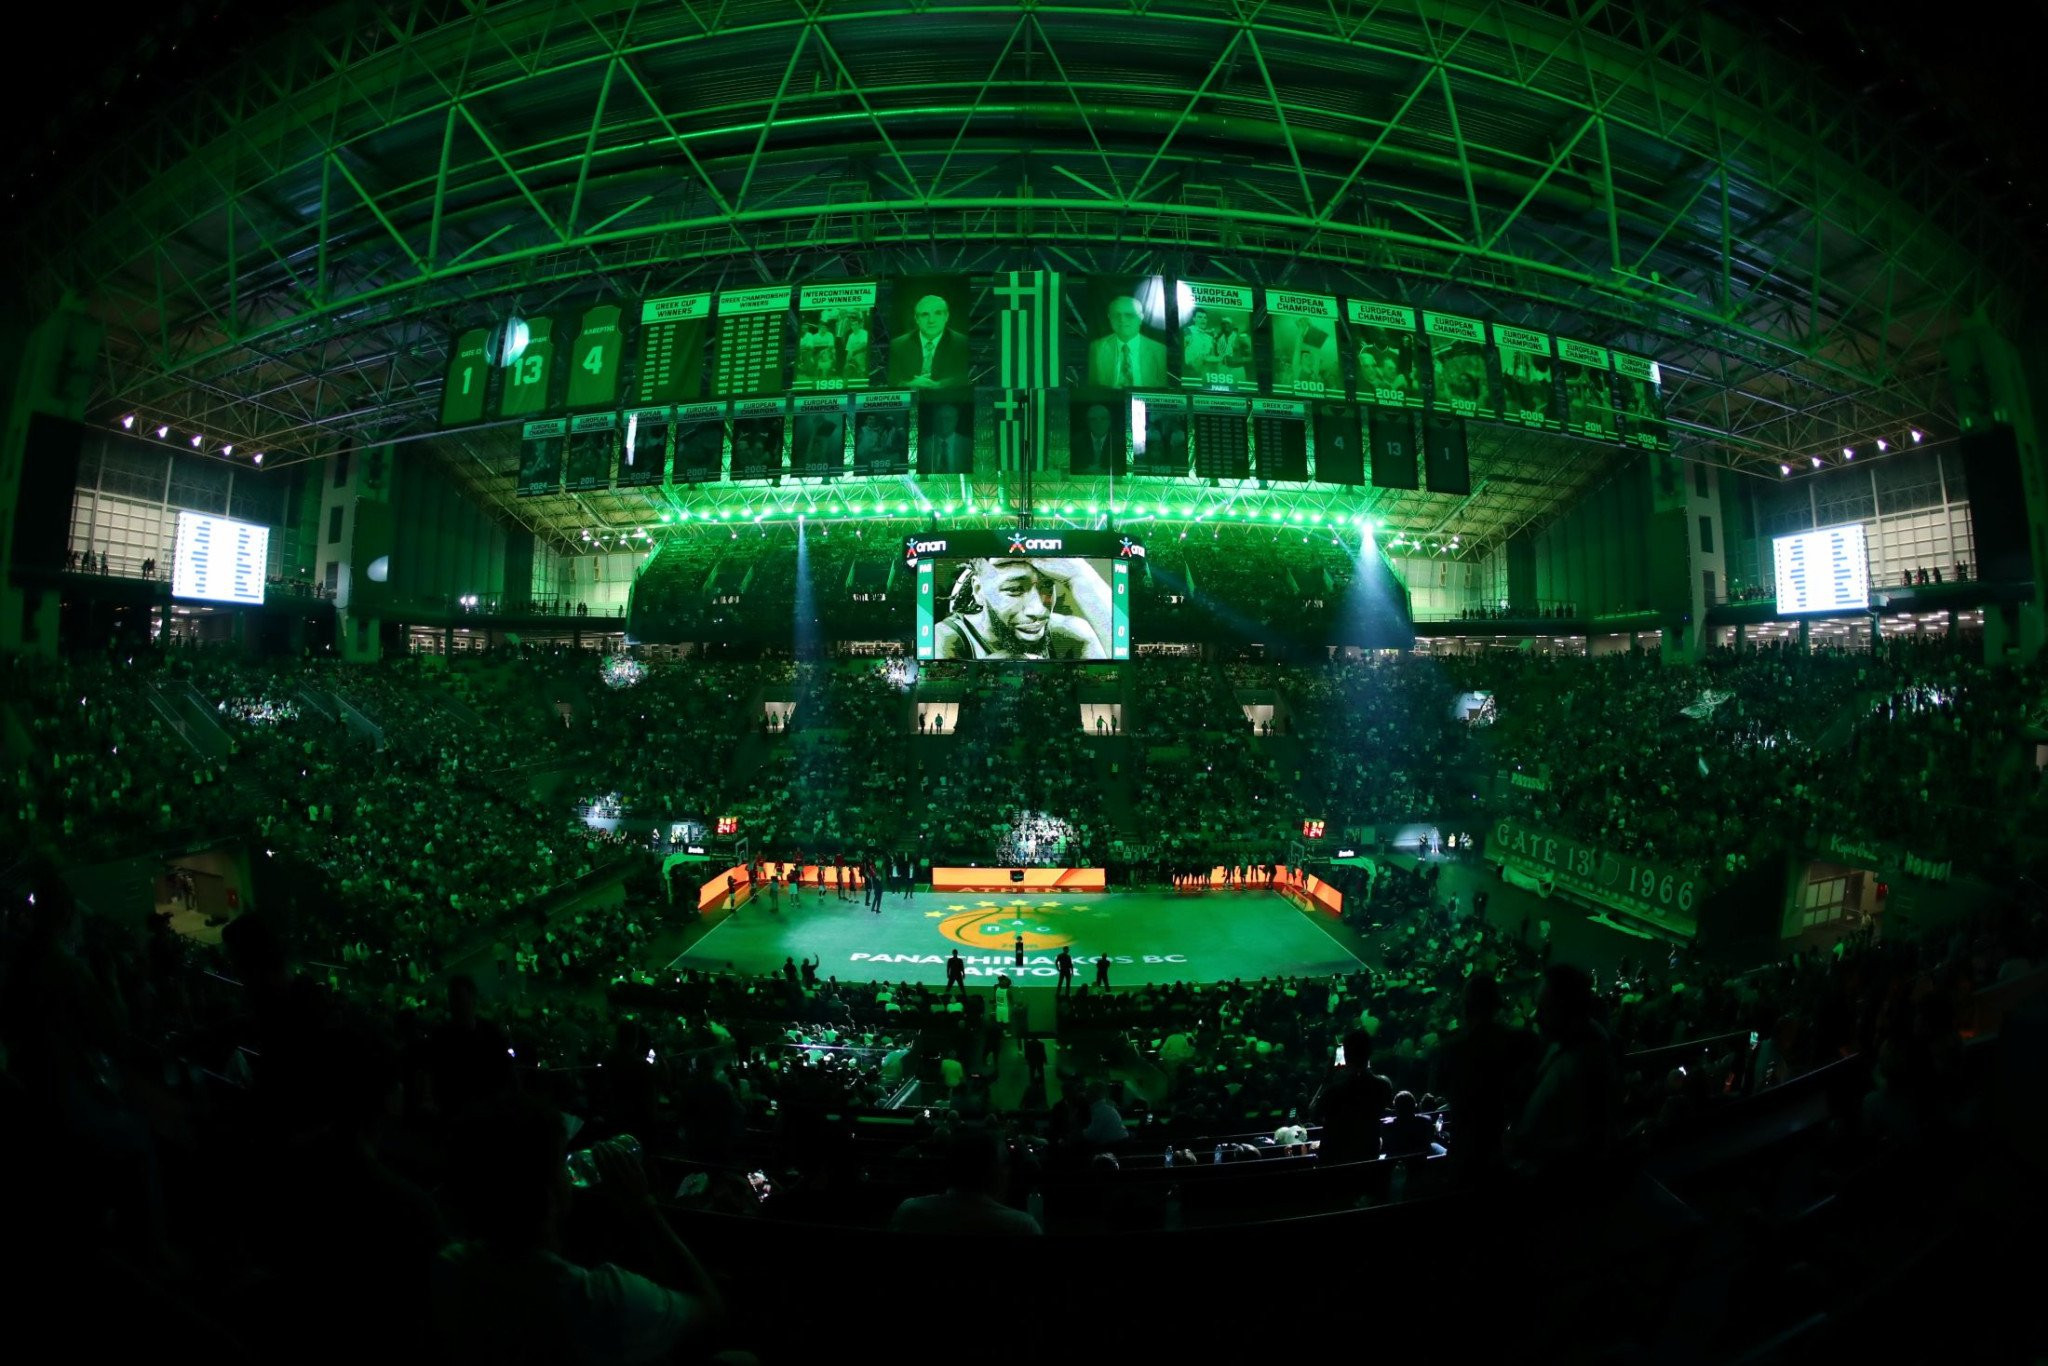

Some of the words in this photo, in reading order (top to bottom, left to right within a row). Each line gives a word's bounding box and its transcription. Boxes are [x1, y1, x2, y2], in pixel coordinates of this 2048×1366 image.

[803, 288, 872, 298] INTERCONTINENTAL
[1191, 286, 1239, 299] EUROPEAN
[655, 300, 681, 310] GREEK
[682, 298, 697, 307] CUP
[739, 300, 769, 309] WINNERS
[811, 297, 827, 305] CUP
[827, 295, 862, 304] WINNERS
[1279, 295, 1325, 308] EUROPEAN
[657, 307, 693, 318] WINNERS
[1277, 302, 1328, 315] CHAMPIONS
[1360, 305, 1403, 318] EUROPEAN
[1358, 312, 1407, 326] CHAMPIONS
[1434, 316, 1474, 331] EUROPEAN
[1433, 323, 1478, 338] CHAMPIONS
[1503, 329, 1540, 343] EUROPEAN
[1502, 336, 1543, 351] CHAMPIONS
[1566, 343, 1600, 357] EUROPEAN
[582, 345, 603, 375] 4
[1565, 350, 1603, 364] CHAMPIONS
[514, 354, 543, 387] 13
[462, 366, 472, 395] 1
[1205, 372, 1234, 384] 1996
[815, 380, 844, 390] 1996
[1293, 380, 1325, 393] 2000
[865, 394, 901, 402] EUROPEAN
[1375, 387, 1405, 401] 2002
[743, 402, 777, 410] EUROPEAN
[800, 404, 839, 412] CHAMPIONS
[803, 398, 838, 406] EUROPEAN
[863, 400, 903, 409] CHAMPIONS
[1262, 401, 1280, 409] GREEK
[1281, 402, 1294, 410] CUP
[1451, 399, 1477, 411] 2007
[684, 411, 719, 420] CHAMPIONS
[686, 406, 717, 414] EUROPEAN
[741, 408, 778, 416] CHAMPIONS
[1520, 409, 1545, 423] 2009
[531, 422, 558, 431] EUROPEAN
[1584, 421, 1602, 433] 2011
[1334, 436, 1345, 450] 4
[1638, 432, 1658, 445] 2024
[1386, 441, 1401, 456] 13
[1444, 447, 1451, 461] 1
[686, 468, 708, 477] 2007
[744, 465, 768, 474] 2002
[804, 463, 829, 471] 2000
[580, 477, 595, 485] 2011
[630, 472, 651, 480] 2009
[529, 482, 548, 491] 2024
[922, 583, 929, 595] 0
[1118, 583, 1125, 595] 0
[922, 625, 929, 637] 0
[1118, 625, 1125, 637] 0
[717, 824, 730, 834] 24
[1309, 827, 1323, 837] 24
[1497, 822, 1558, 866] GATE
[1567, 846, 1590, 877] 13
[1628, 865, 1695, 912] 1966
[1142, 954, 1188, 964] BC
